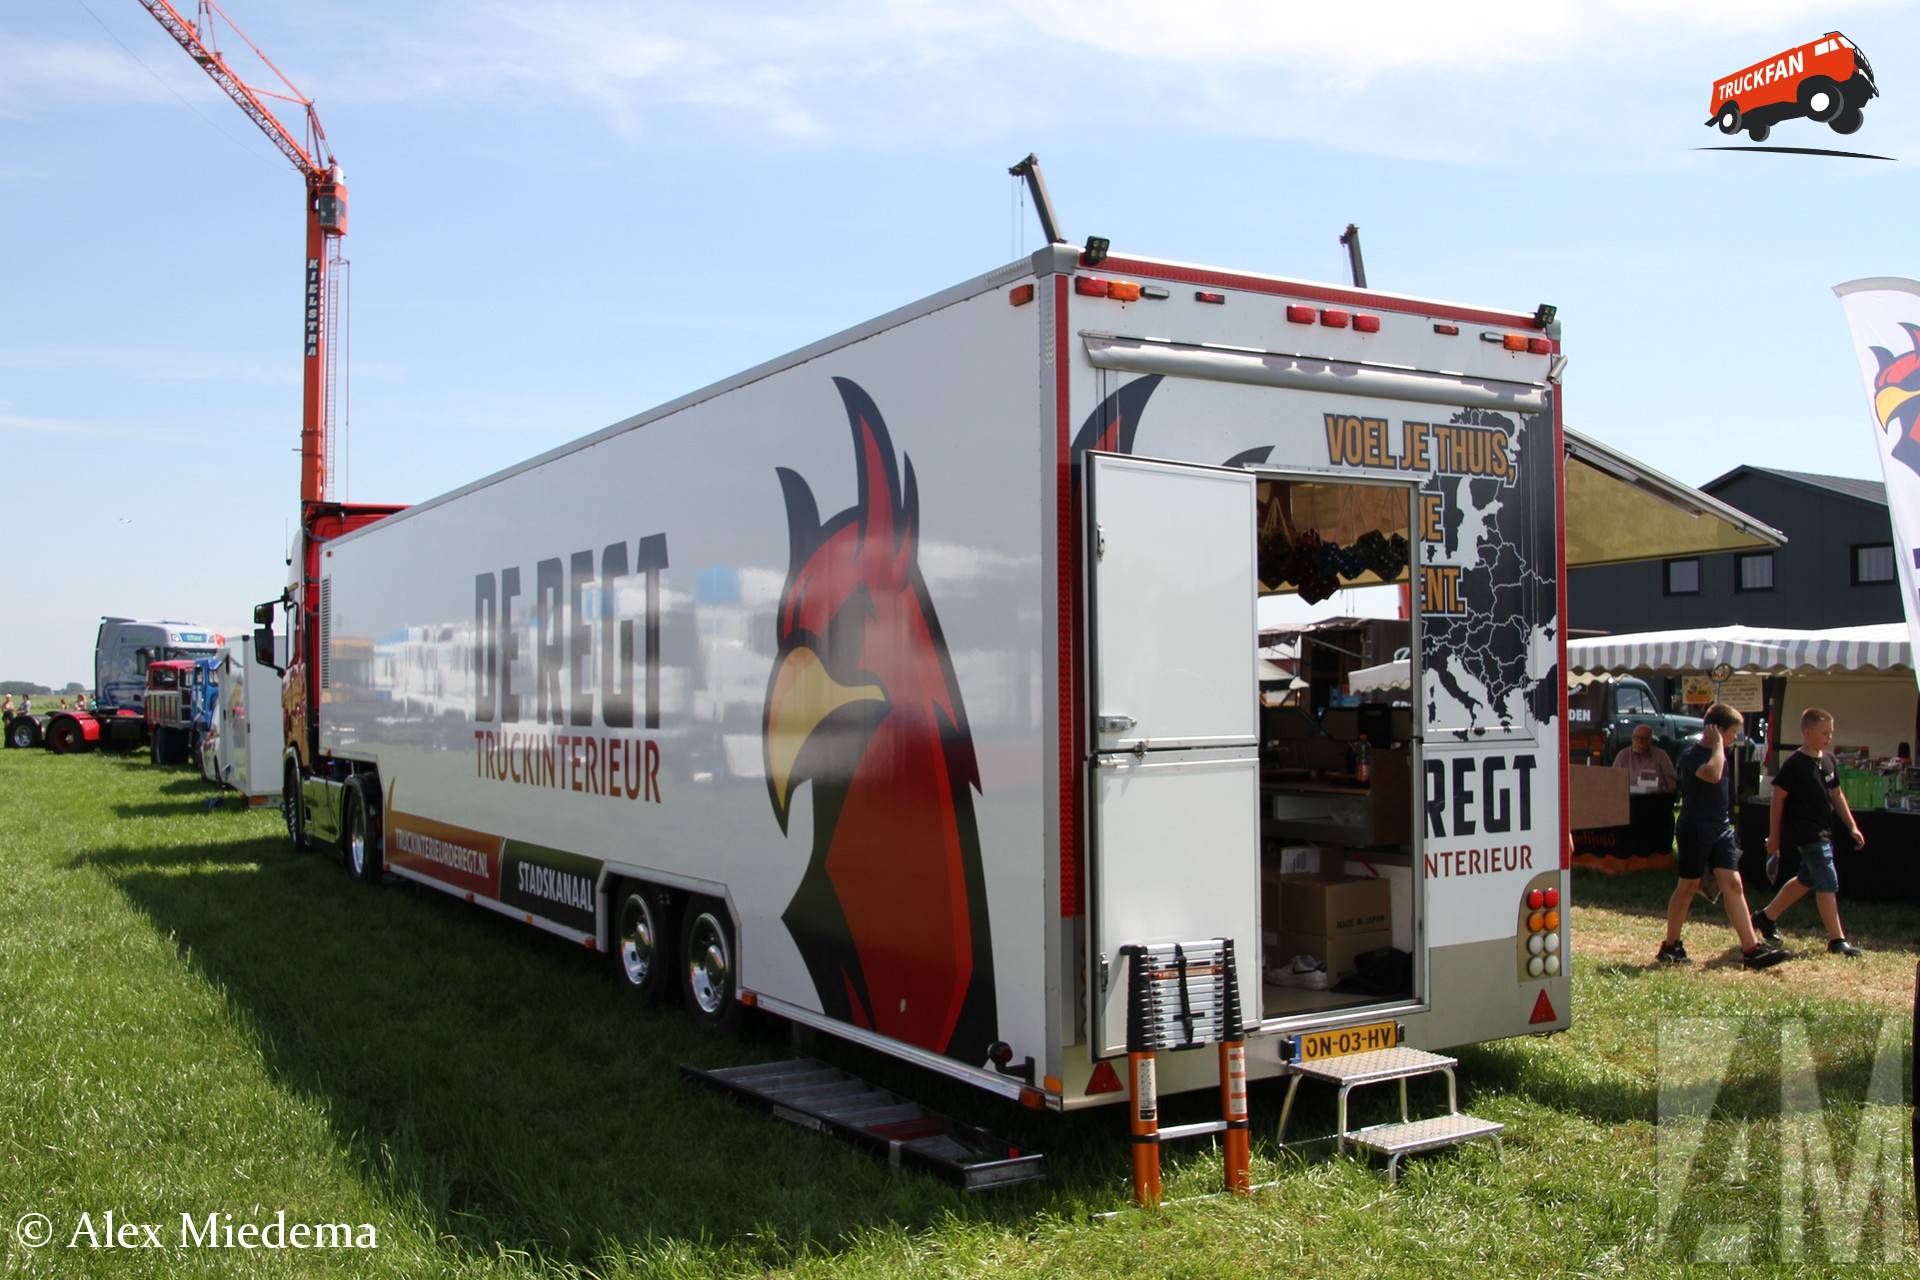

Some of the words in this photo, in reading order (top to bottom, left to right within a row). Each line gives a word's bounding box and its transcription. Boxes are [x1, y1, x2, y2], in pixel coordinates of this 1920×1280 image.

[307, 259, 318, 356] KIELSTRA
[1324, 413, 1397, 466] VOEL
[1401, 420, 1430, 472] JE
[1432, 423, 1514, 487] THUIS,
[475, 566, 521, 723] DE
[537, 532, 669, 729] REGT
[474, 730, 662, 803] TRUCKINTERIEUR
[1423, 754, 1537, 839] REGT
[395, 828, 490, 878] TRUCKINTERIEURDEREGT.NL
[518, 861, 594, 912] STADSKANAAL
[1306, 1027, 1391, 1058] ON-03-HV
